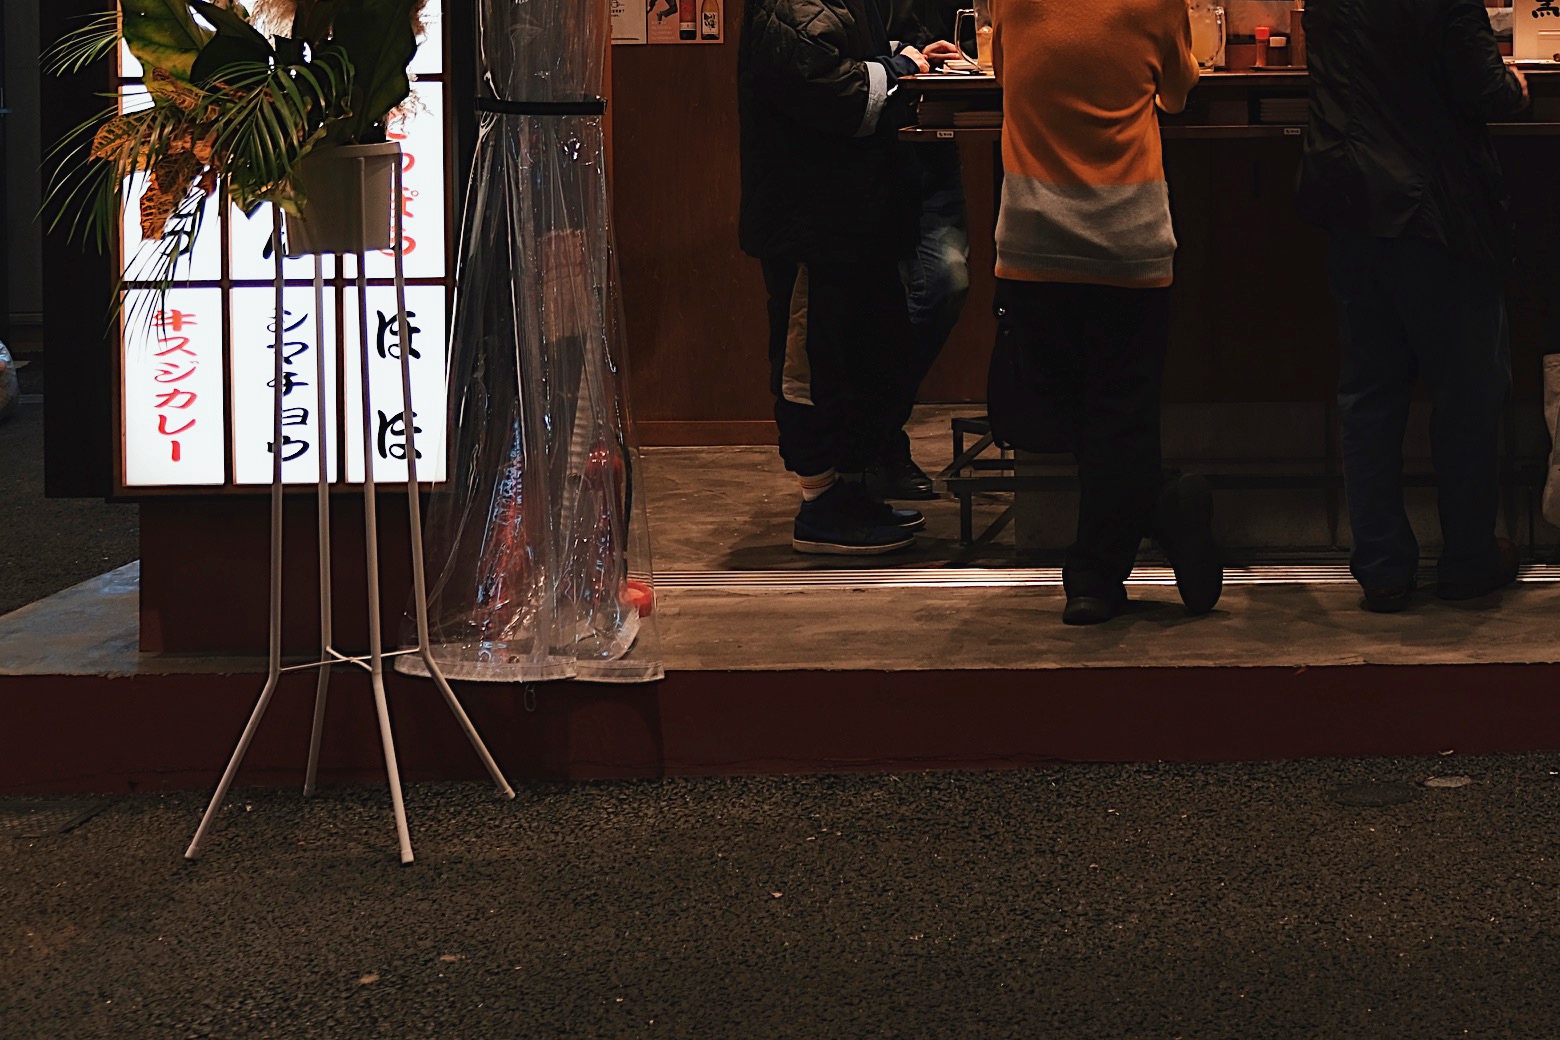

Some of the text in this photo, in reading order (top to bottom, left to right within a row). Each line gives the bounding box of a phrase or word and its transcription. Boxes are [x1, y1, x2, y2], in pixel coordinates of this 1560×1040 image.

[152, 309, 199, 462] 牛スジカレー
[266, 308, 310, 462] シマチョウ
